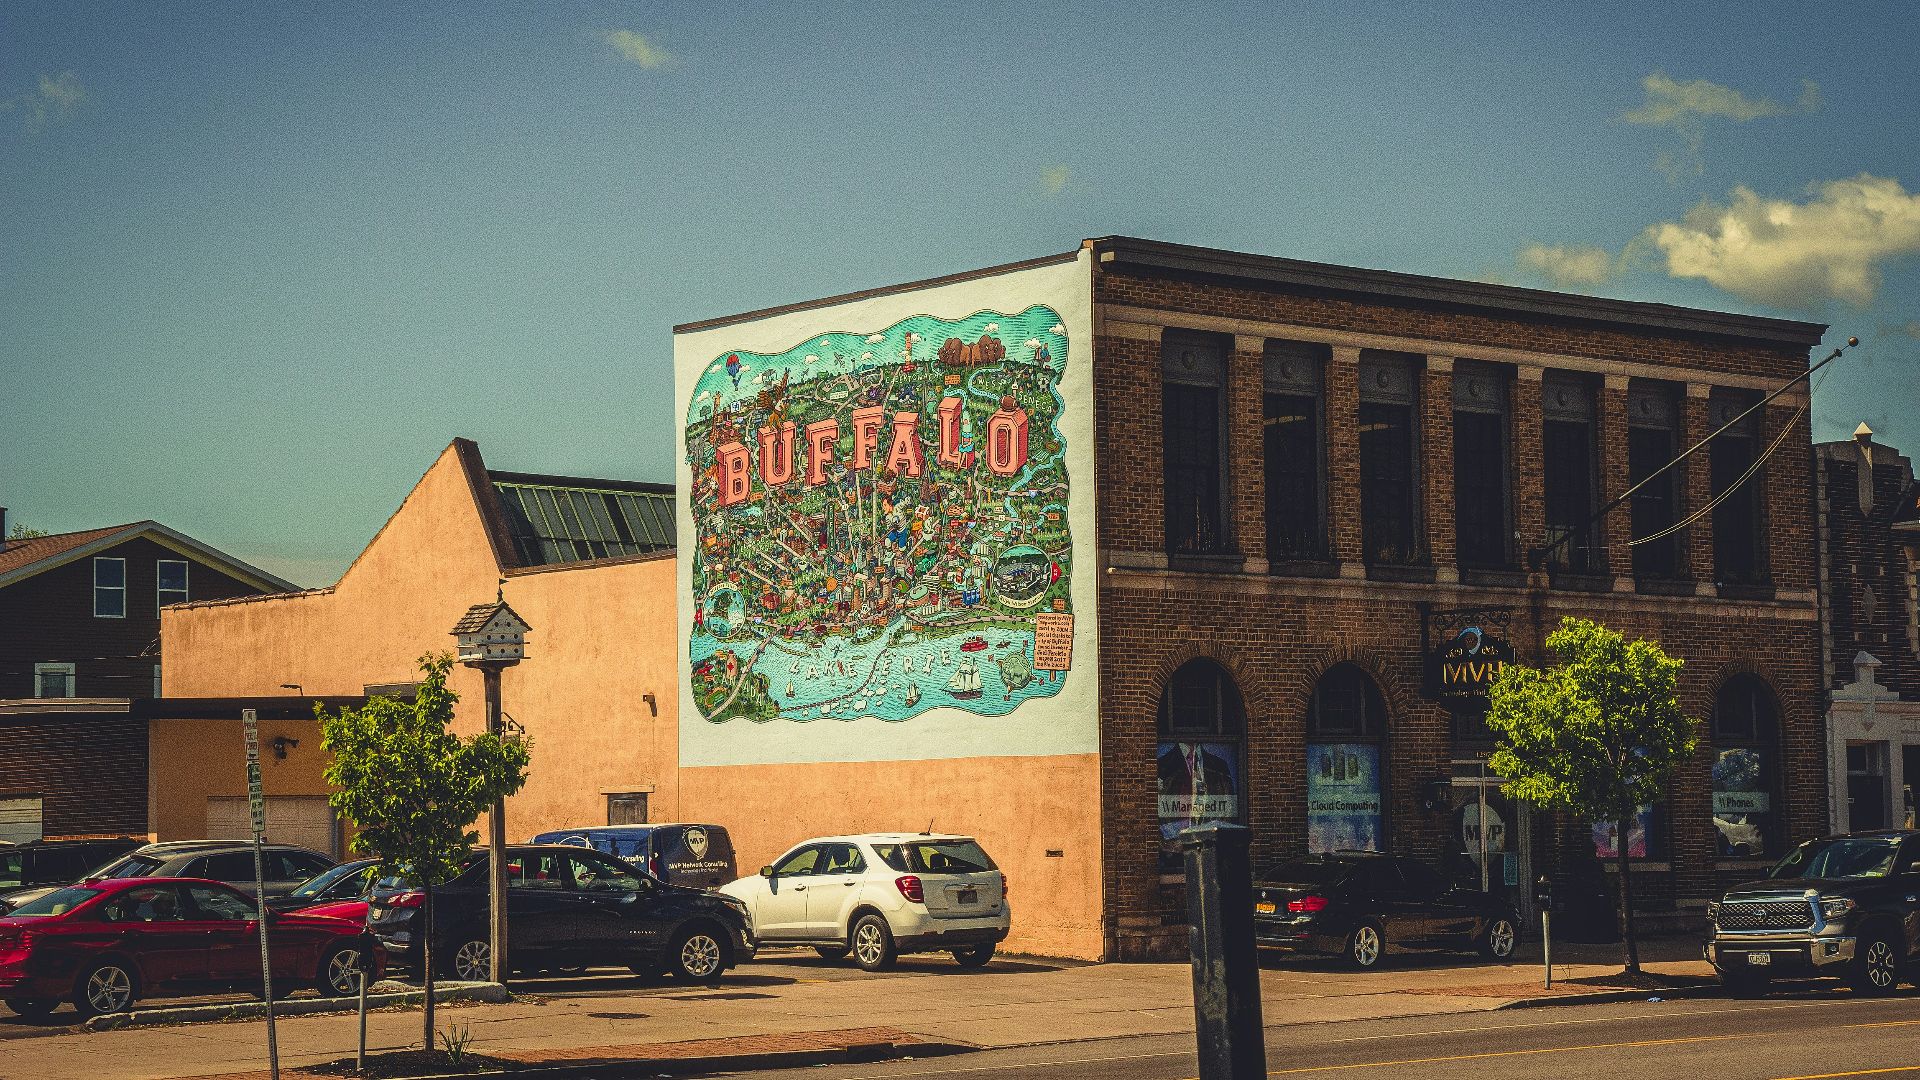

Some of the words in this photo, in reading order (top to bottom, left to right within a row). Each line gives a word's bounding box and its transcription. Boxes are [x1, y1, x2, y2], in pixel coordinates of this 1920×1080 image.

[1018, 390, 1053, 413] SENECA
[715, 397, 1029, 506] BUFFALO
[789, 659, 859, 681] LAKE
[880, 649, 952, 677] ERIE
[1171, 801, 1217, 814] Managed
[1218, 801, 1228, 812] IT
[1311, 800, 1334, 811] Cloud
[1335, 800, 1378, 813] Computing
[1726, 796, 1755, 808] Phones
